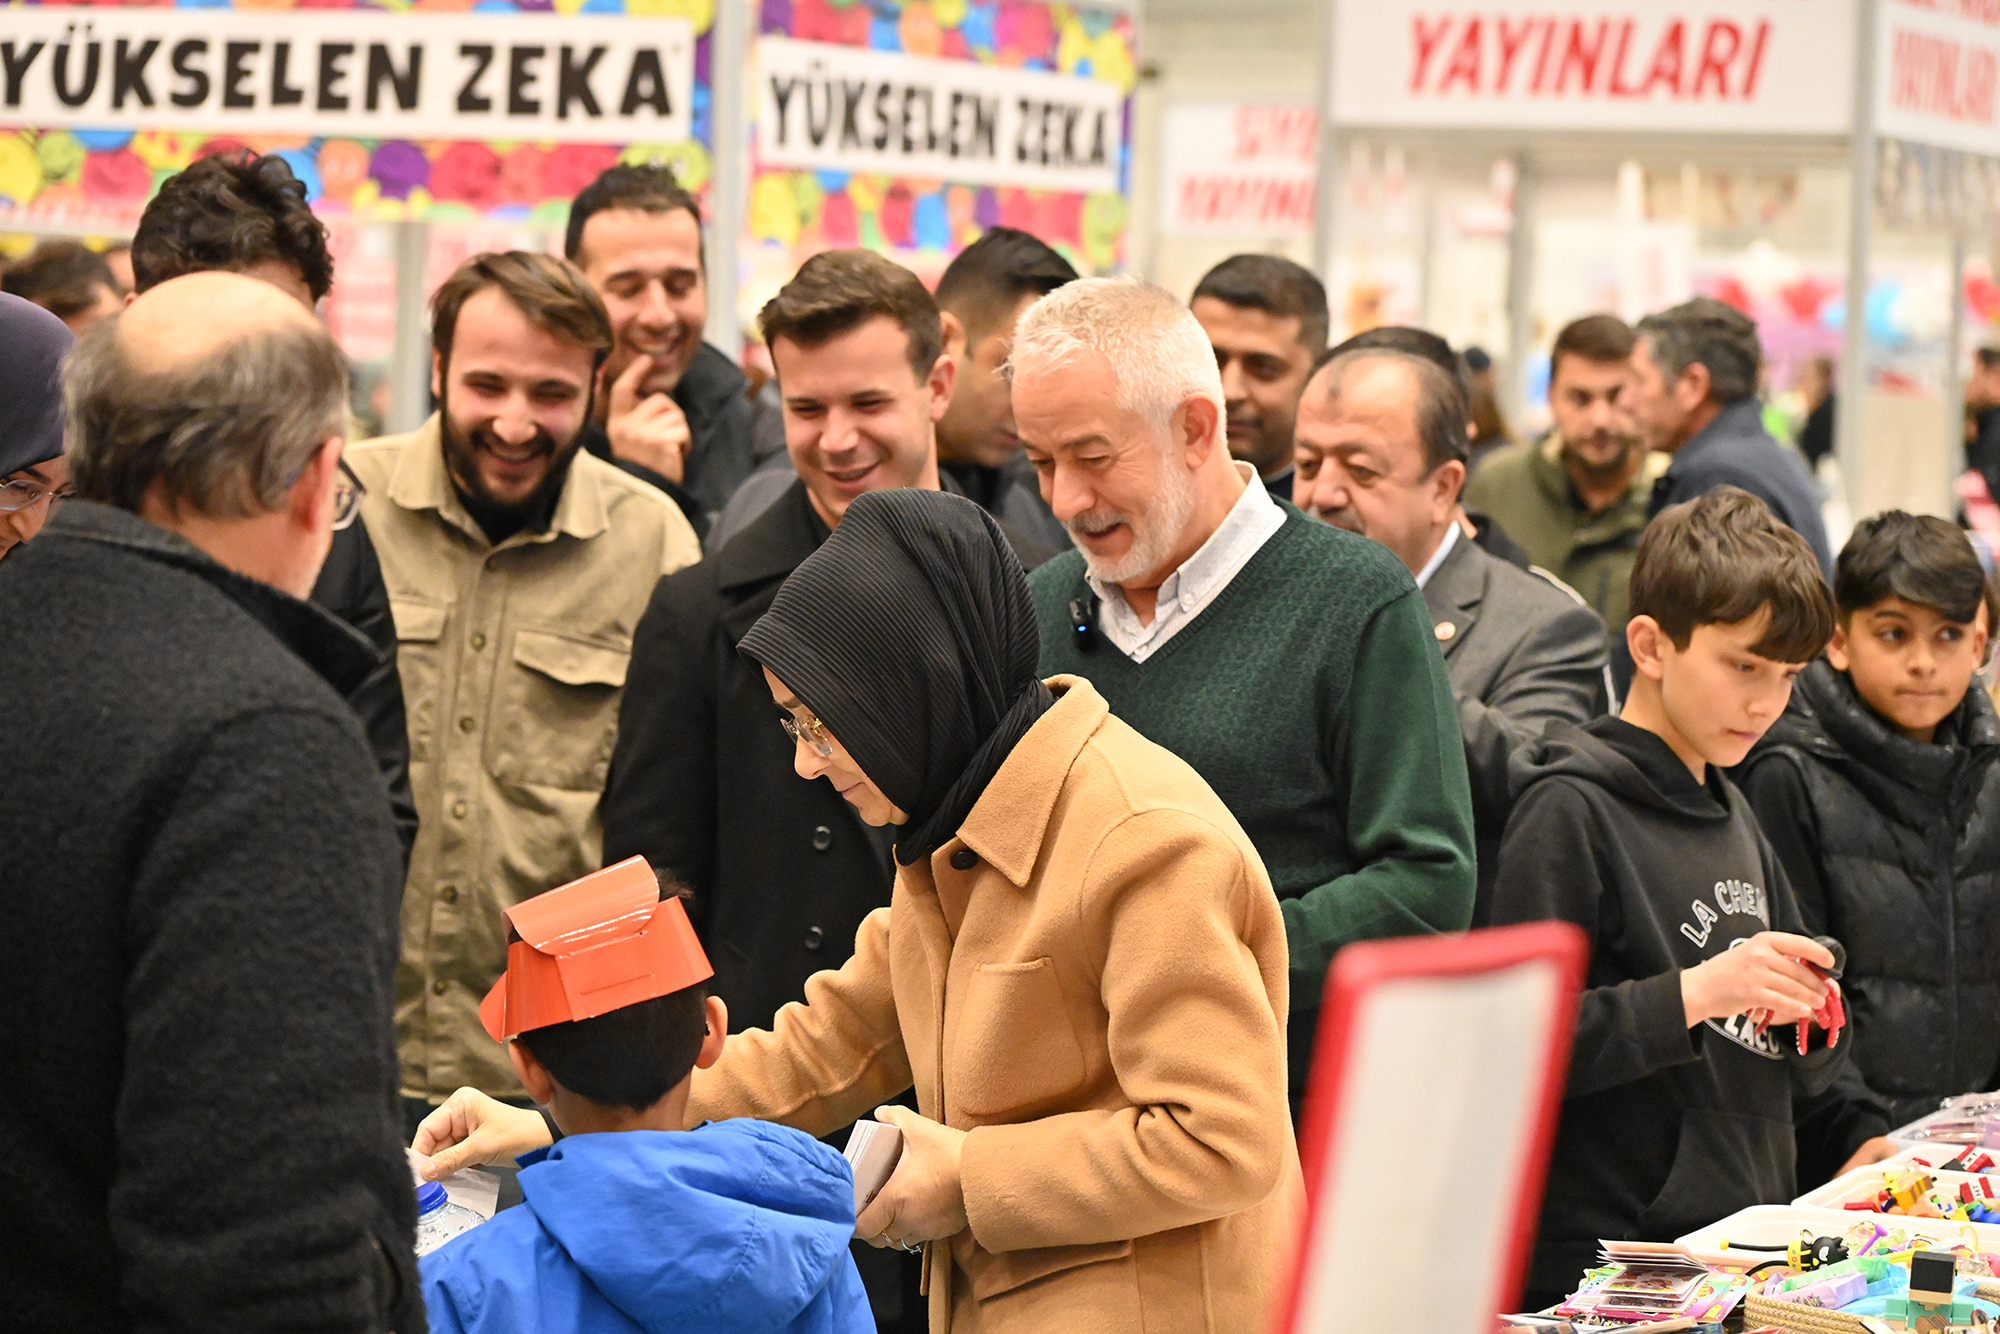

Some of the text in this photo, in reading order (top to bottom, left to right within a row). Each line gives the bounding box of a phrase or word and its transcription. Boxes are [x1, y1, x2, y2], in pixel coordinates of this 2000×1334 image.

[0, 24, 672, 120] YÜKSELEN ZEKA
[1409, 15, 1773, 98] YAYINLARI
[771, 58, 1106, 166] YÜKSELEN ZEKA
[1680, 899, 1718, 948] LA
